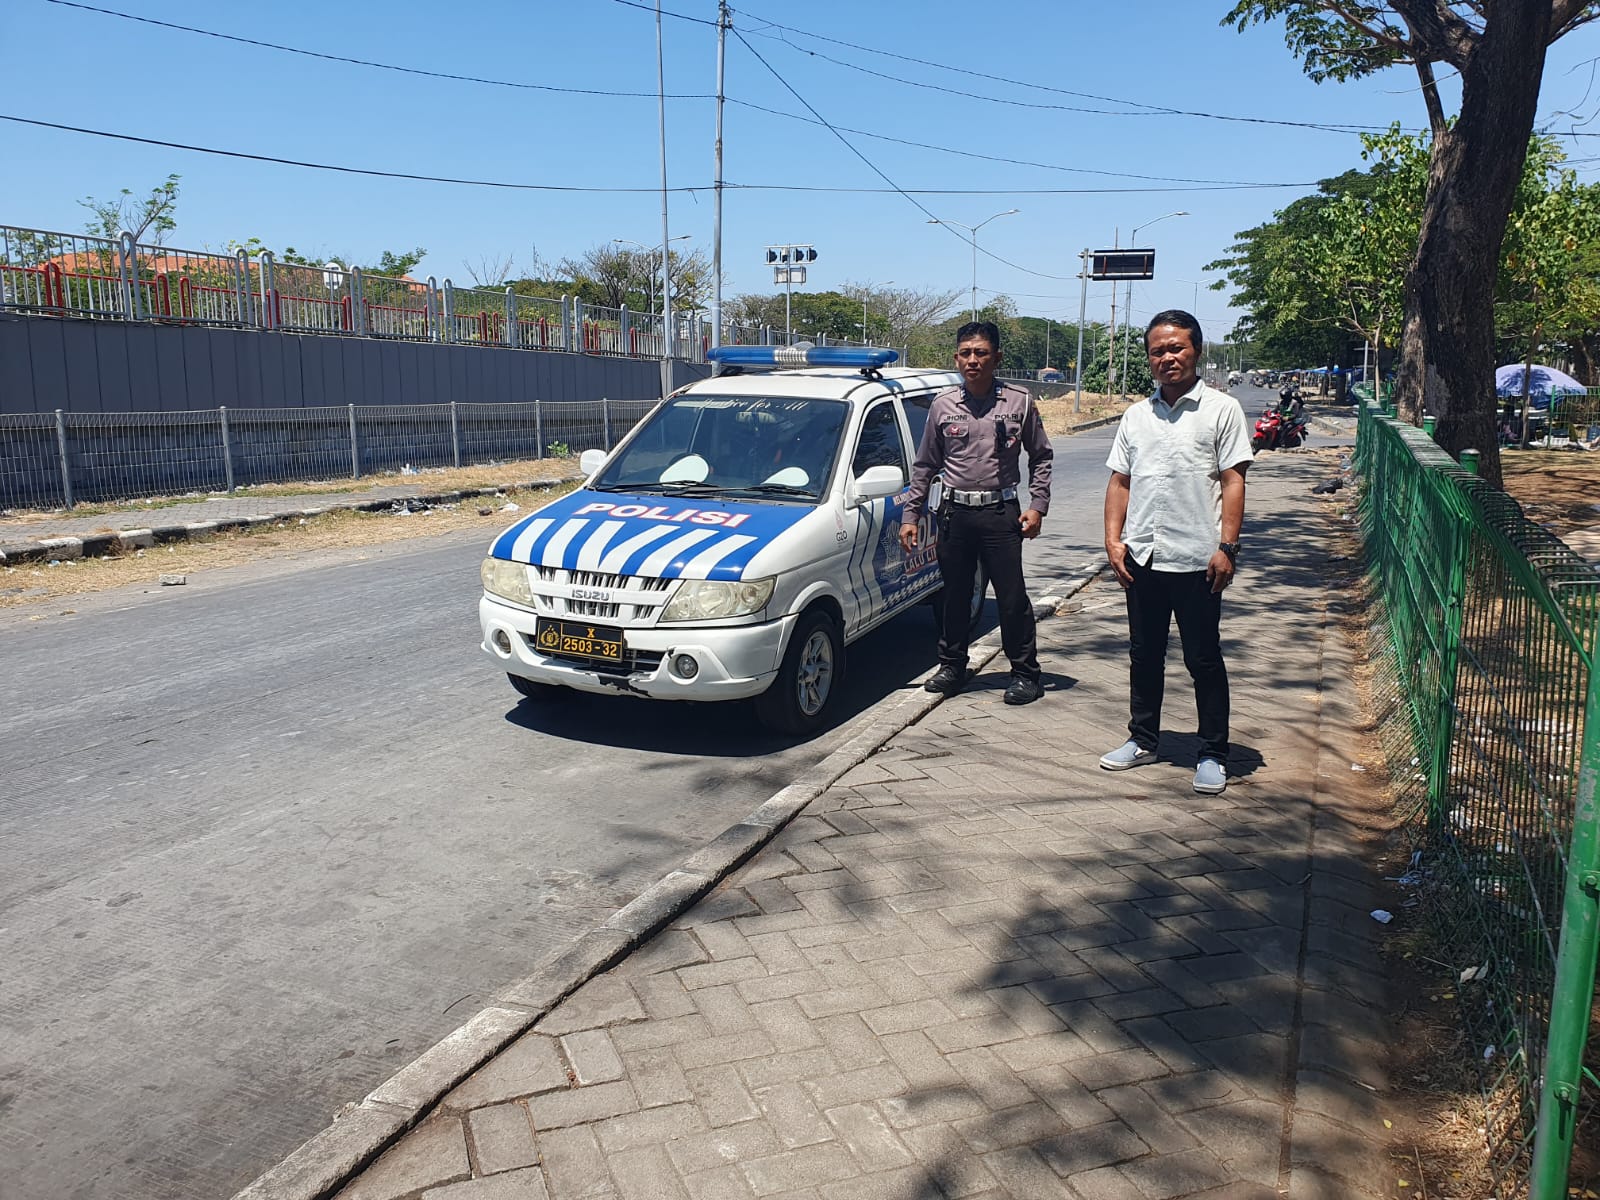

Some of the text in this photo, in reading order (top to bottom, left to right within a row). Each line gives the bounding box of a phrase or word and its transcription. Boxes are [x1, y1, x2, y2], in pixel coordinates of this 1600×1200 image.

[572, 502, 752, 528] POLISI
[904, 552, 925, 572] LALU
[572, 589, 609, 601] ISUZU
[587, 627, 596, 639] X
